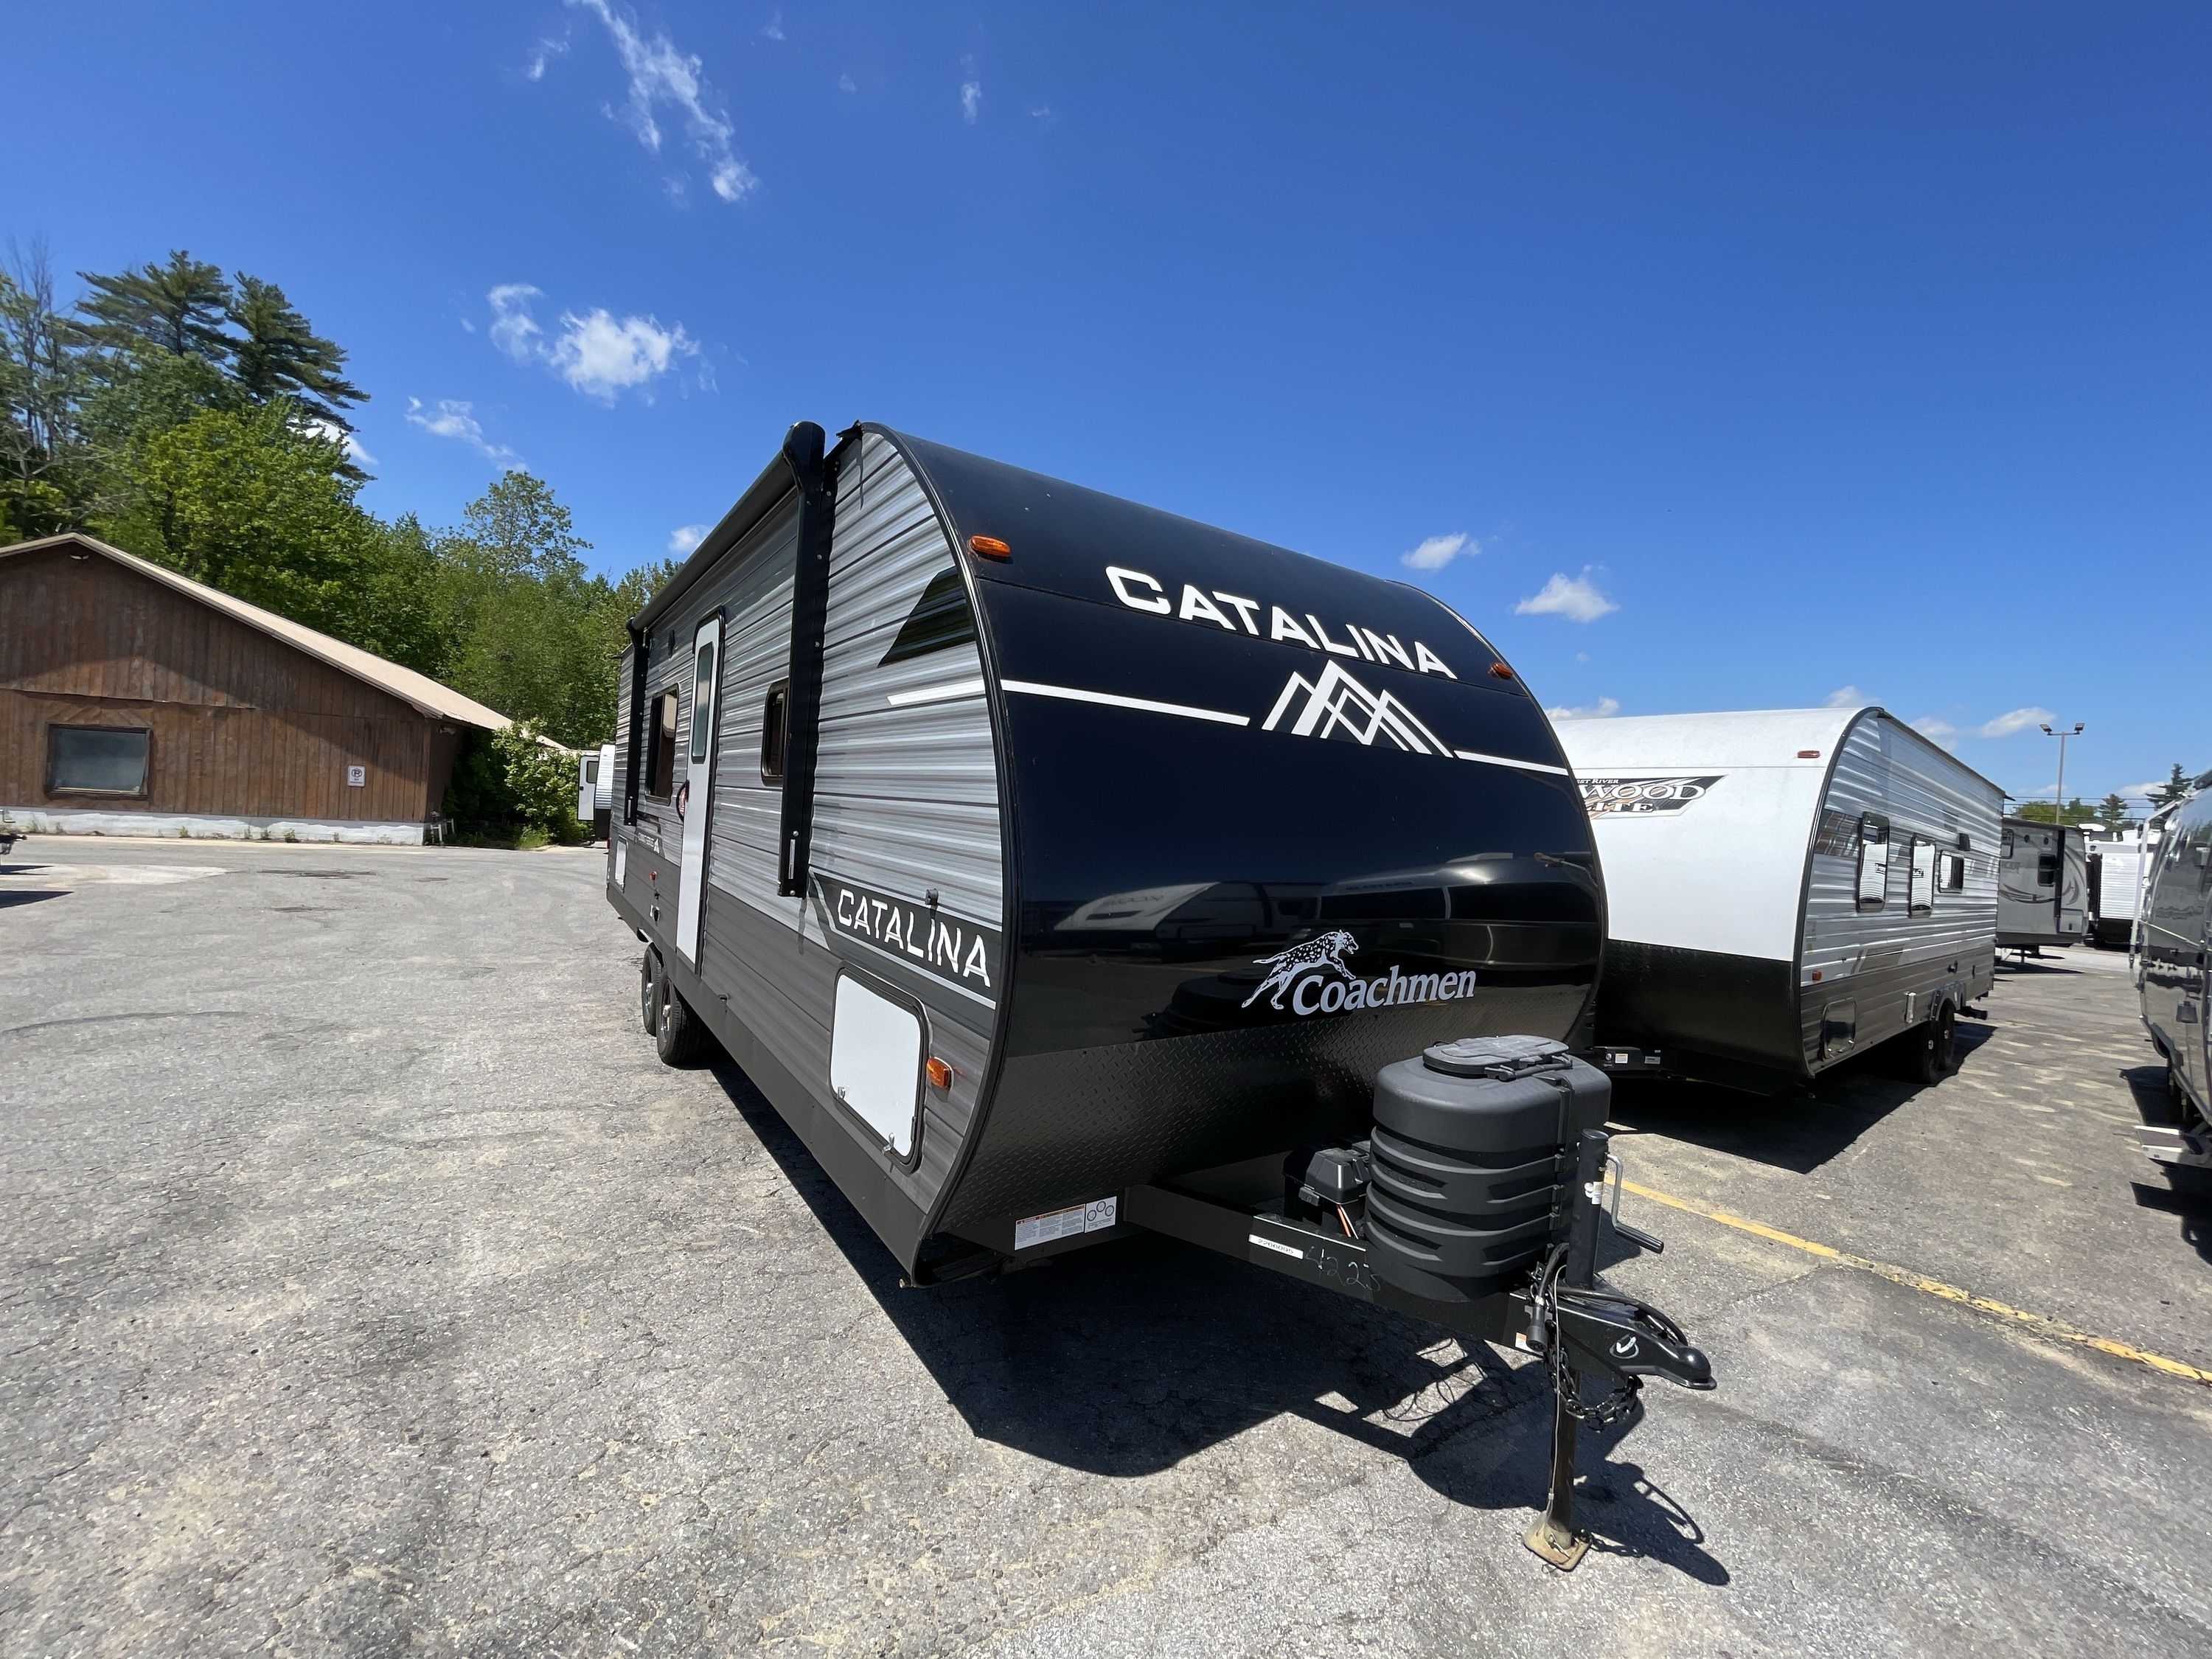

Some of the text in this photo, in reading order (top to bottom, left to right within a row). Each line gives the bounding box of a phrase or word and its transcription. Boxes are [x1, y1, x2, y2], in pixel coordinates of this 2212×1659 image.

[1106, 566, 1458, 679] CATALINA
[838, 888, 991, 987] CATALINA
[1293, 965, 1477, 1015] Coachmen
